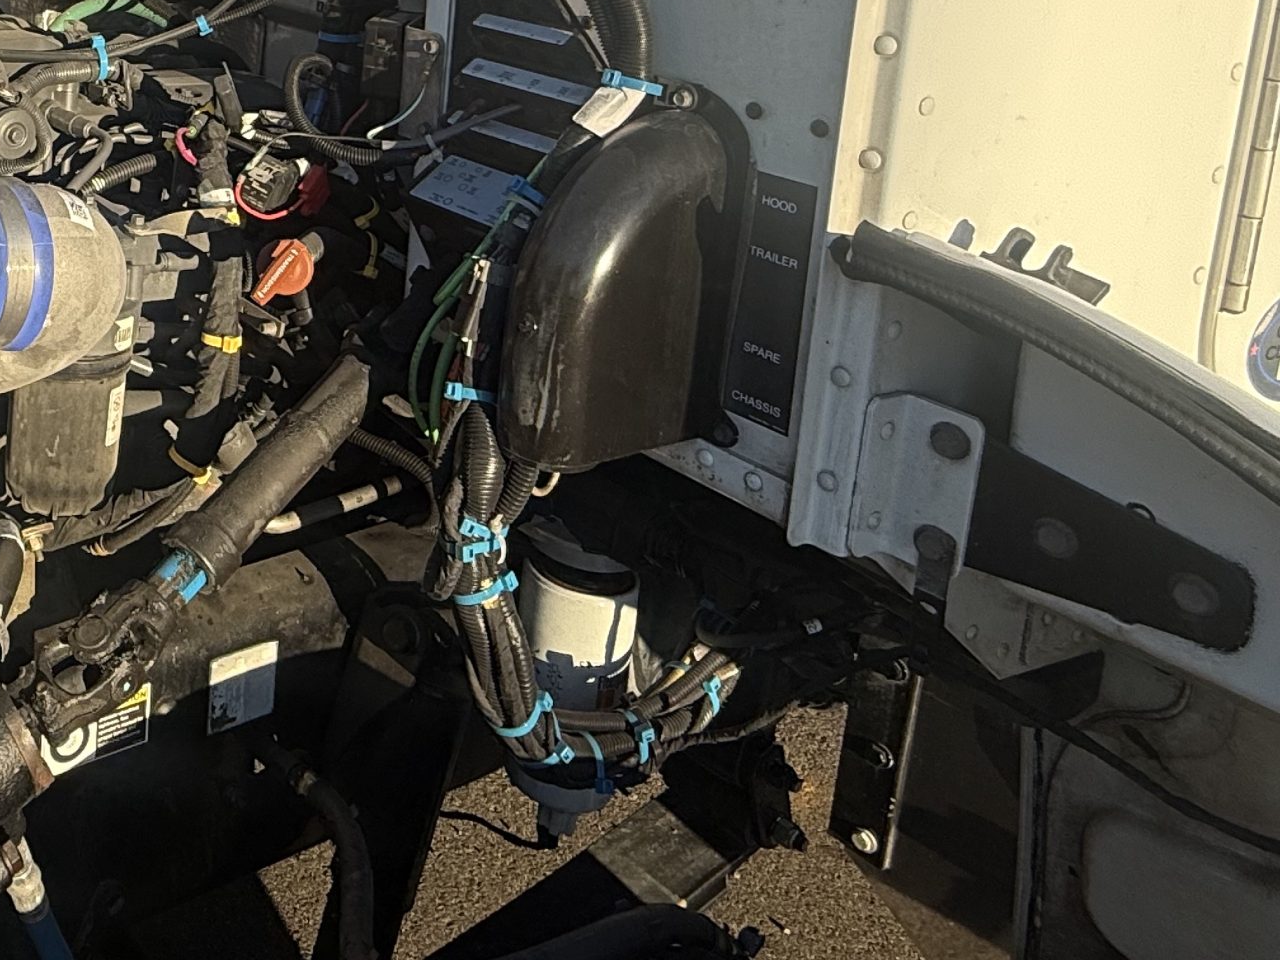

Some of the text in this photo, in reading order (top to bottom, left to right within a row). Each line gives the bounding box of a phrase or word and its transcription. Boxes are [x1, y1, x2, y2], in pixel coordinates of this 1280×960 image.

[761, 194, 798, 214] HOOD
[750, 245, 799, 270] TRAILER
[743, 341, 781, 365] SPARE
[731, 389, 782, 418] CHASSIS
